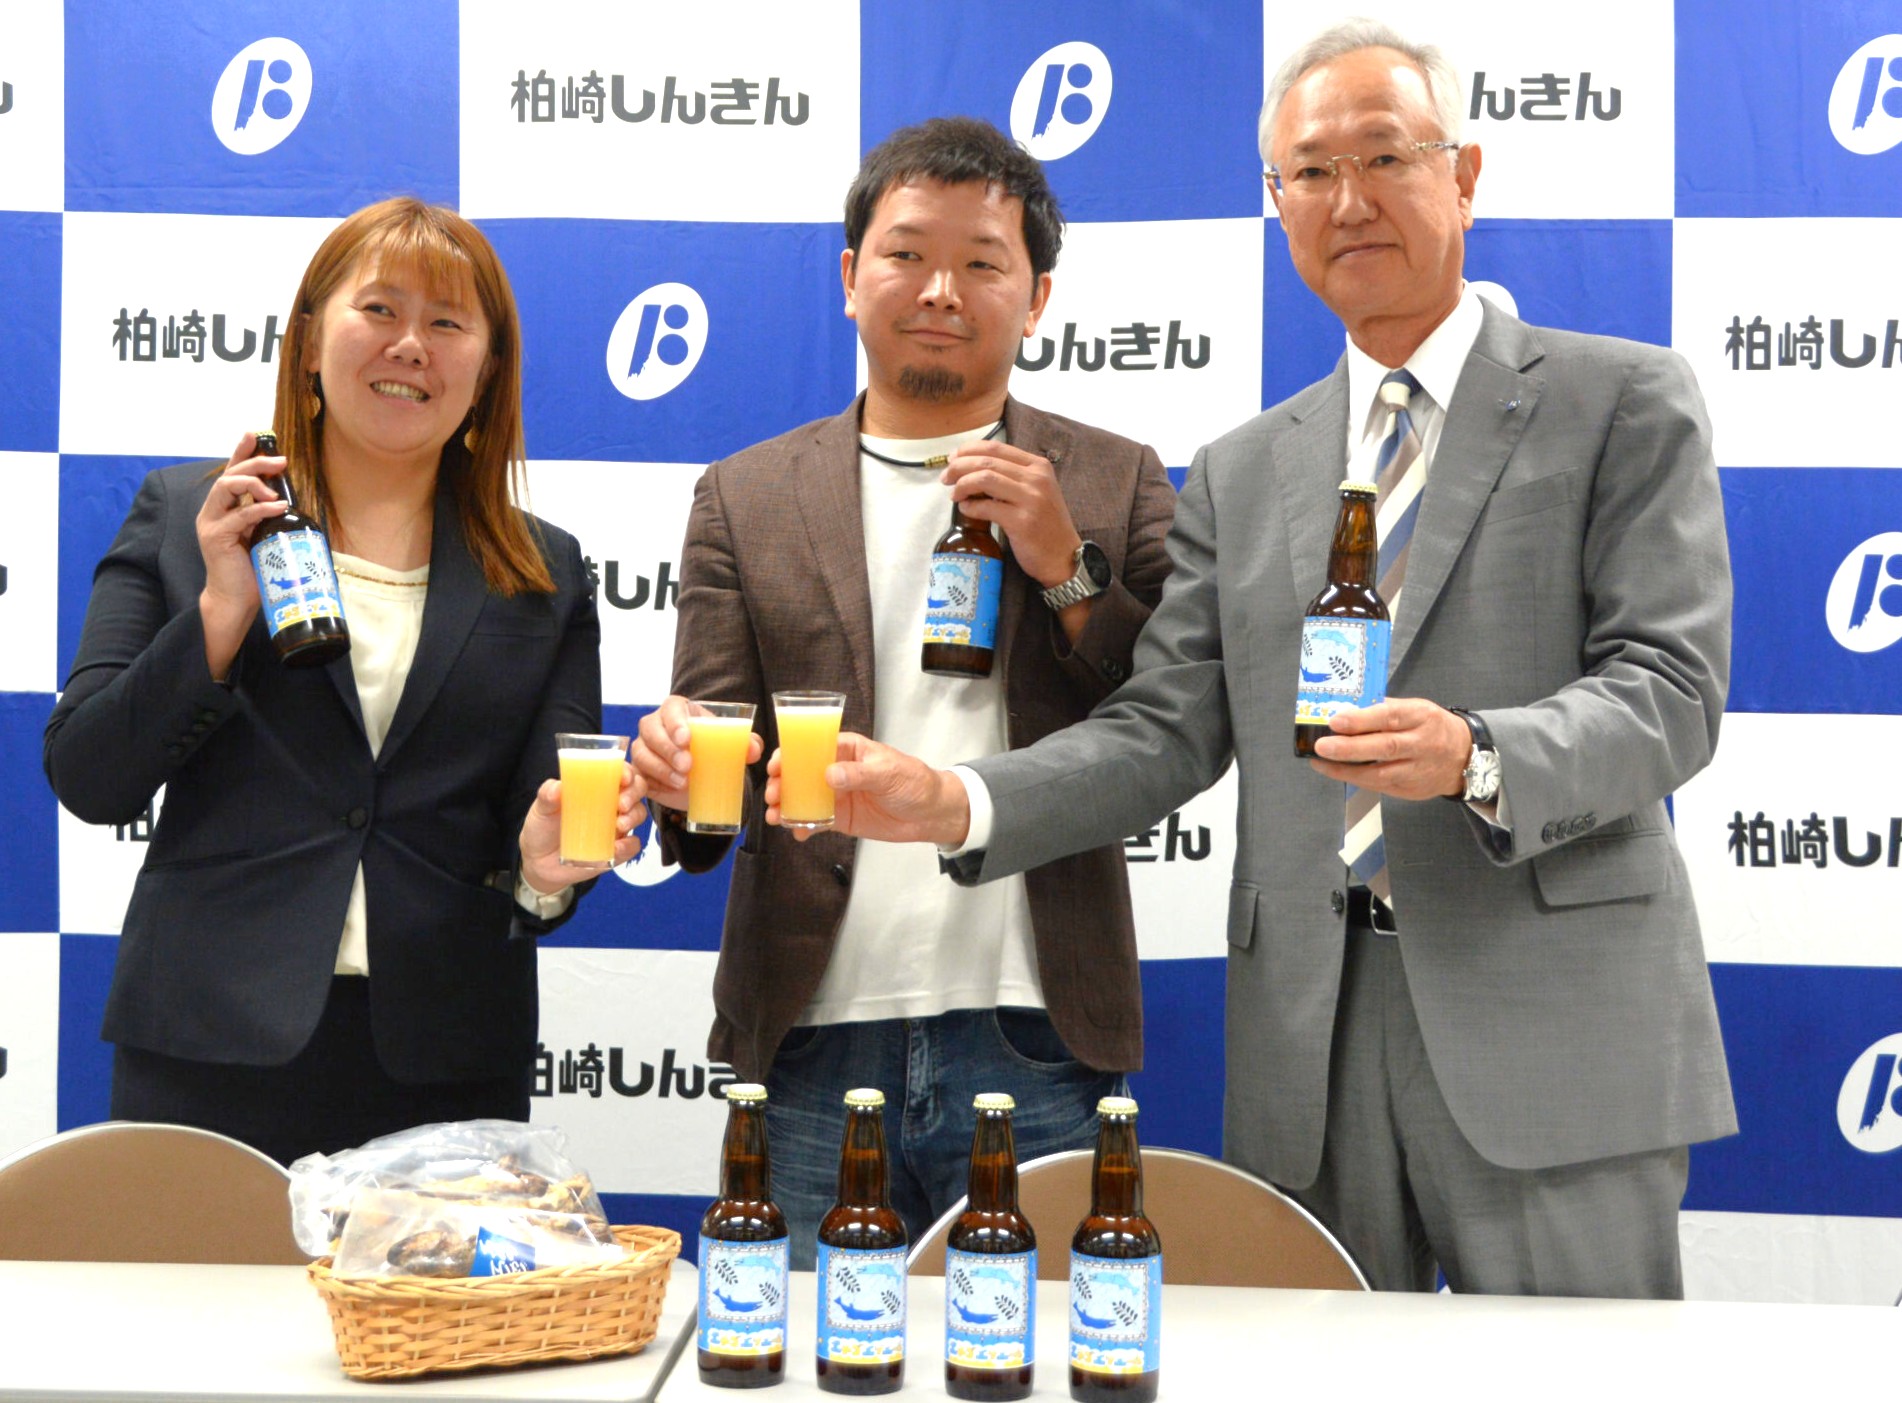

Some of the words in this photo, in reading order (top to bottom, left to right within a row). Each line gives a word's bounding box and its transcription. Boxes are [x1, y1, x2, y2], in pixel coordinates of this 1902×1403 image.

[511, 69, 809, 126] 柏崎しんきん
